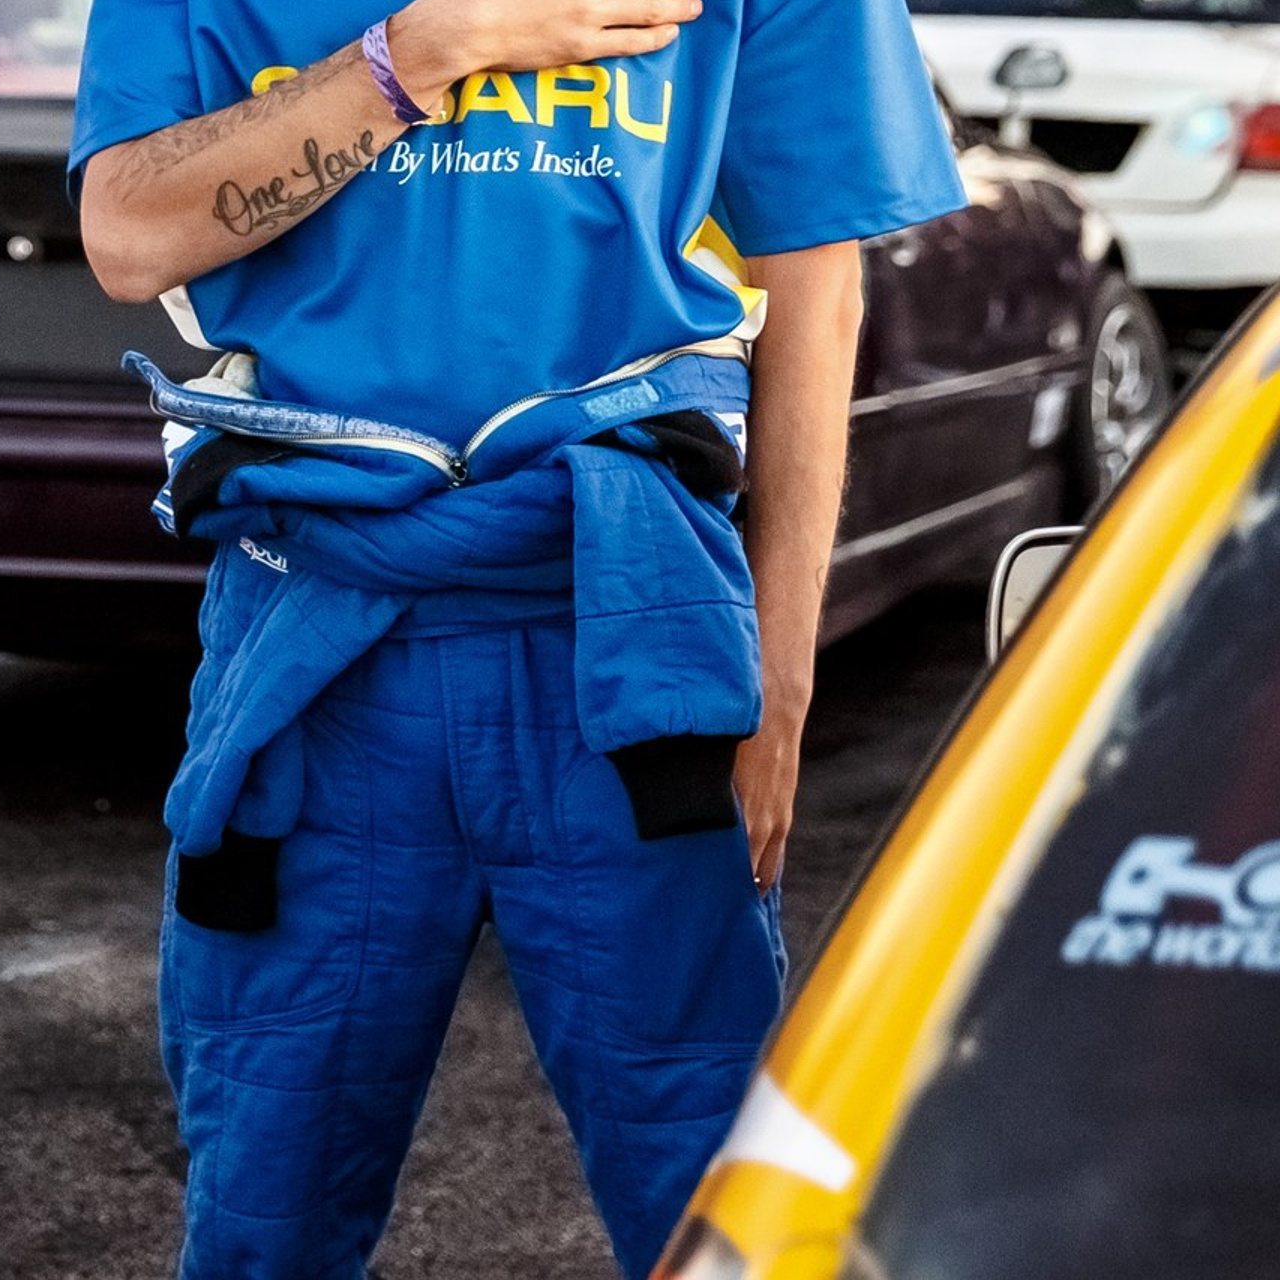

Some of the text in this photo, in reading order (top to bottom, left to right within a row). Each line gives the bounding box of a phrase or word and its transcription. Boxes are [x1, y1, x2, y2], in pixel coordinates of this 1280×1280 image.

[213, 129, 376, 236] One Love
[388, 140, 426, 185] By
[431, 139, 521, 175] What's
[529, 139, 623, 179] Inside.
